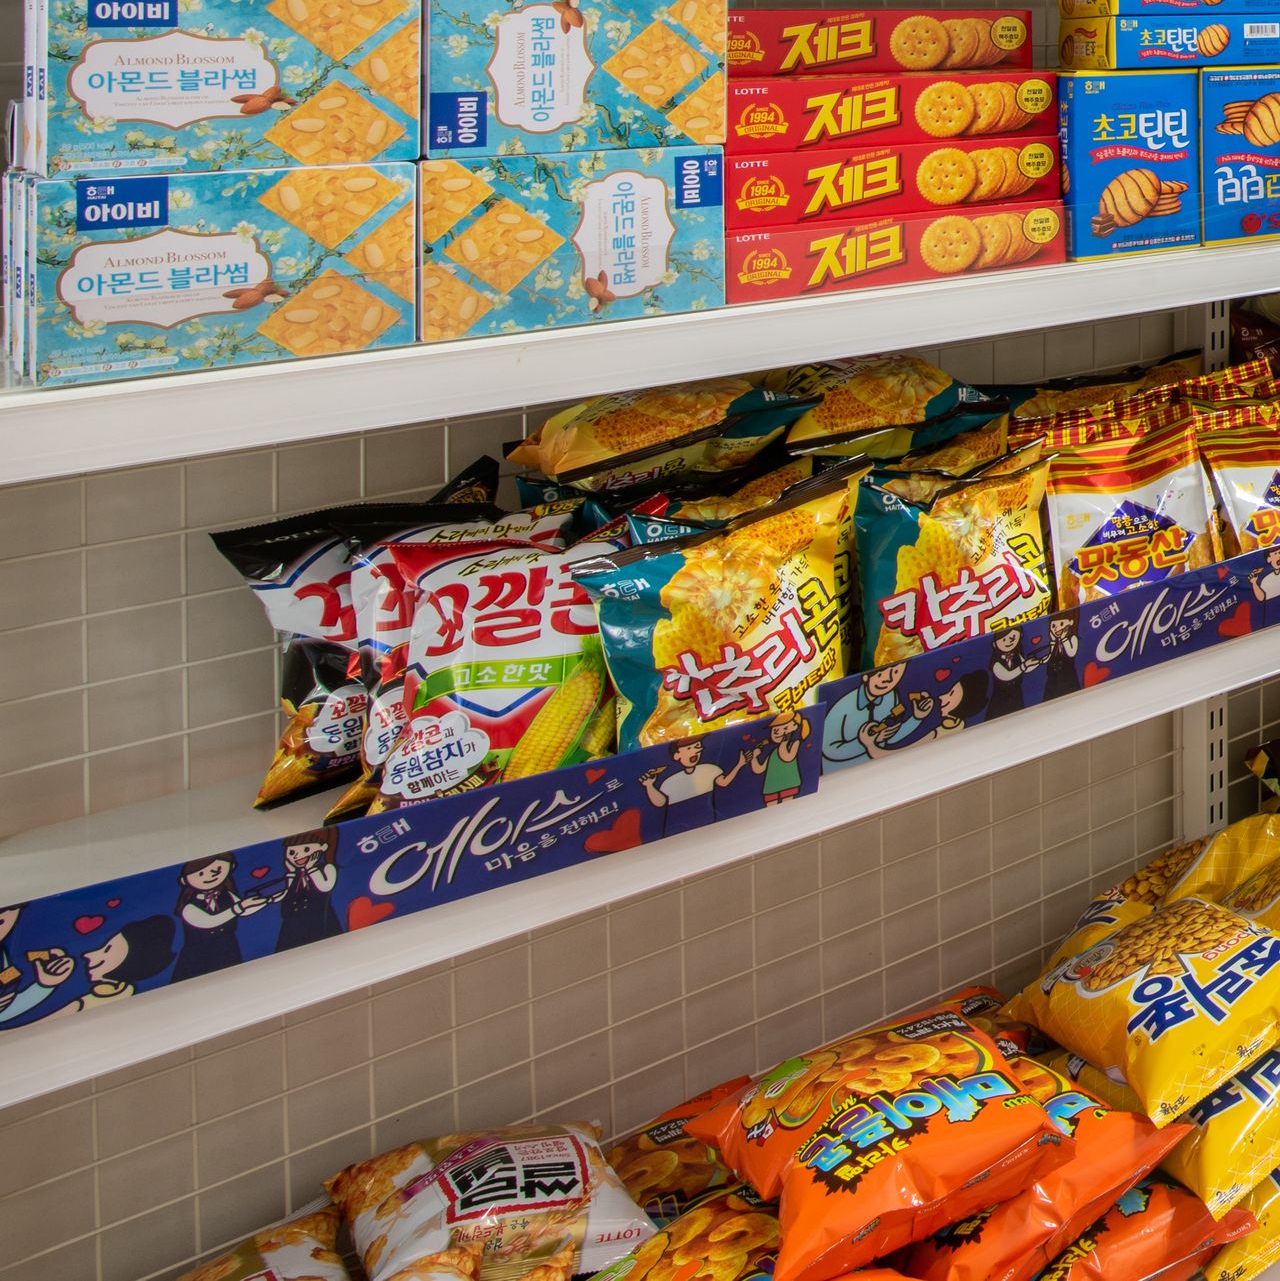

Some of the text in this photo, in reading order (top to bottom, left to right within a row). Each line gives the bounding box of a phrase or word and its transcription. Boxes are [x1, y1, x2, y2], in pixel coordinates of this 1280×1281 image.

[95, 1, 170, 21] 아이비
[779, 20, 874, 71] 제크
[1140, 27, 1198, 52] 초코틴틴
[114, 52, 235, 67] ALMOND BLOSSOM
[531, 17, 555, 122] 아몬드 블라썸
[88, 67, 257, 94] 아몬드 블라썸
[734, 86, 769, 96] LOTTE
[457, 96, 479, 144] 아이비
[744, 124, 780, 134] ORIGINAL
[749, 110, 776, 125] 1994
[803, 87, 898, 143] 제크
[1092, 109, 1191, 151] 초코틴틴
[735, 159, 769, 169] LOTTE
[682, 159, 700, 205] 아이비
[750, 184, 776, 198] 1994
[804, 155, 900, 215] 제크
[84, 200, 160, 223] 아이비
[744, 197, 781, 207] ORIGINAL
[612, 181, 637, 286] 아몬드 블라썸
[736, 232, 771, 243] LOTTE
[104, 250, 227, 269] ALMOND BLOSSOM
[752, 257, 778, 271] 1994
[807, 224, 903, 287] 제크
[76, 262, 249, 298] 아몬드 블라썸
[746, 269, 783, 281] ORIGINAL
[1077, 532, 1188, 584] 맛동산
[1094, 584, 1229, 662] 에이스
[1160, 618, 1203, 647] 마음을
[368, 787, 588, 896] 에이스
[484, 799, 622, 875] 마음을 전해요!
[799, 1071, 1017, 1172] 메이플콘
[833, 1137, 911, 1183] 카라멜
[594, 1227, 641, 1244] LOTTE
